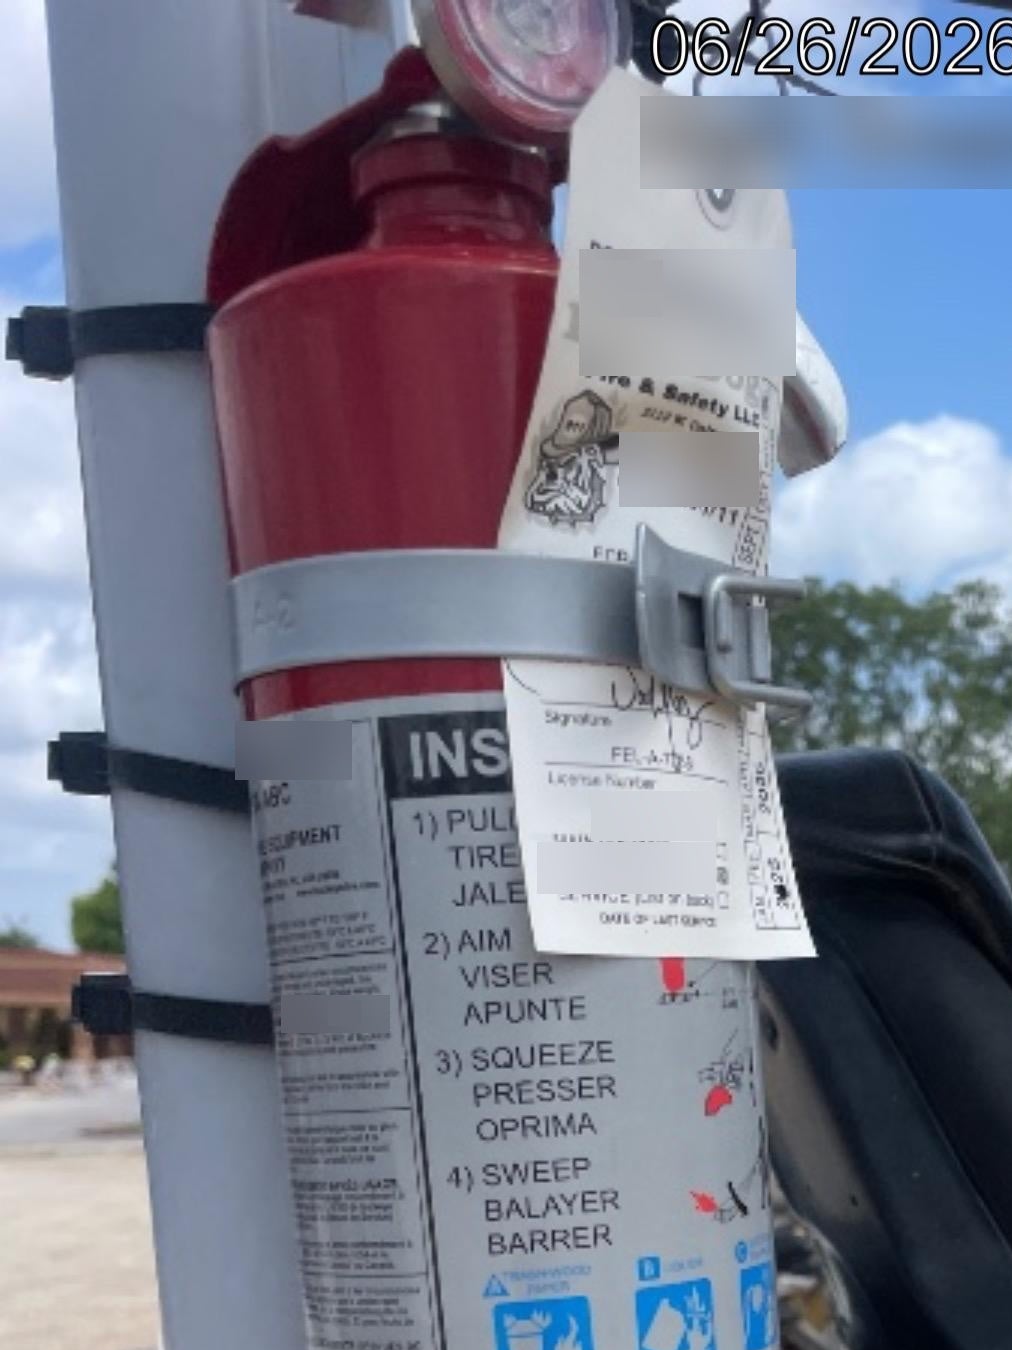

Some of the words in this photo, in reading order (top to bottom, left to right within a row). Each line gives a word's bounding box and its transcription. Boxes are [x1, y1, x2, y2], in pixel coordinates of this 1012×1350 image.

[639, 377, 654, 396] &
[663, 383, 730, 418] Safety
[544, 710, 613, 728] Signature
[409, 727, 511, 780] INS
[413, 811, 438, 841] 1)
[450, 842, 522, 870] TIRE
[453, 880, 527, 908] JALE
[423, 932, 450, 960] 2)
[458, 927, 512, 953] AIM
[460, 961, 555, 990] VISER
[463, 996, 588, 1028] APUNTE
[435, 1048, 464, 1078] 3)
[471, 1039, 616, 1072] SQUEEZE
[472, 1076, 617, 1107] PRESSER
[476, 1113, 598, 1143] OPRIMA
[446, 1163, 475, 1193] 4)
[481, 1157, 592, 1187] SWEEP
[484, 1189, 621, 1223] BALAYER
[487, 1224, 614, 1257] BARRER
